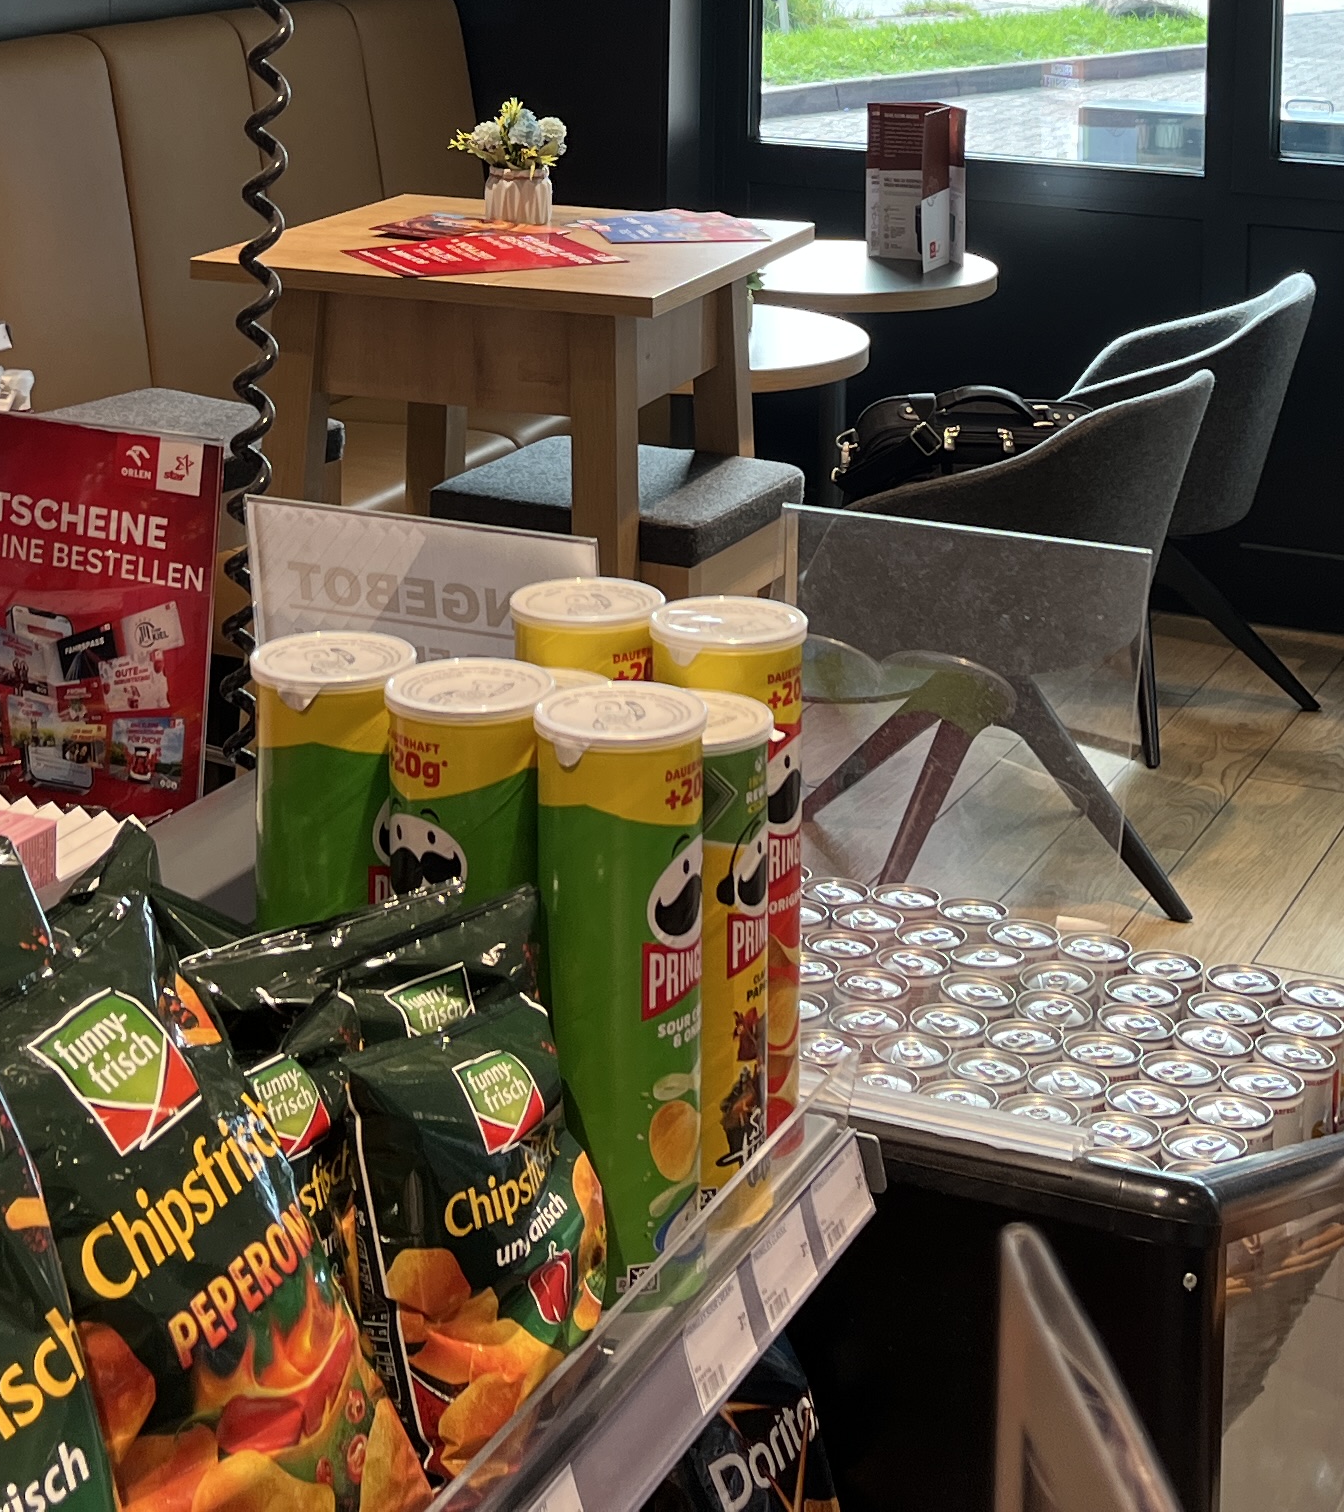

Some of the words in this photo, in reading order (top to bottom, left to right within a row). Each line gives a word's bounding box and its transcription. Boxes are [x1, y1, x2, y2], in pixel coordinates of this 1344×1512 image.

[121, 467, 153, 481] ORLEN
[163, 469, 186, 483] star
[52, 542, 205, 592] BESTELLEN
[114, 666, 140, 678] GUTE
[418, 994, 465, 1031] frisch
[54, 1010, 128, 1066] funny-
[88, 1029, 162, 1096] frisch
[467, 1060, 513, 1095] funny-
[253, 1068, 304, 1104] funny-
[265, 1083, 315, 1125] frisch
[483, 1076, 529, 1114] frisch
[80, 1092, 288, 1300] Chipsfrisch
